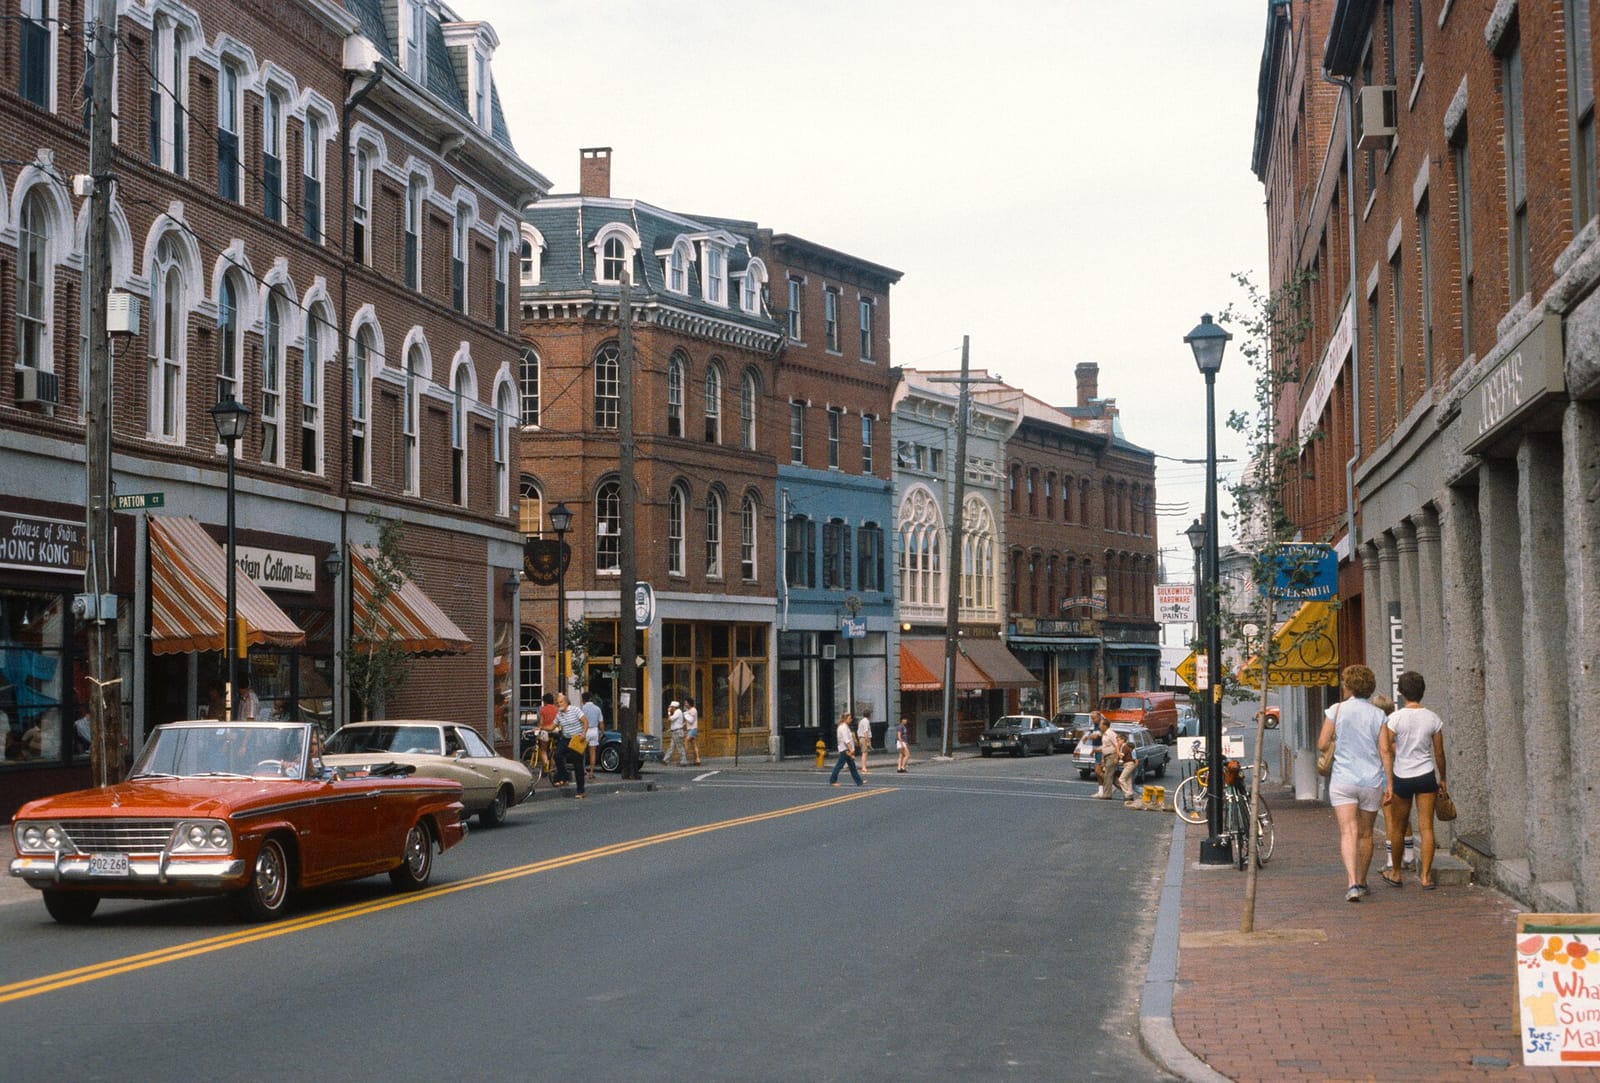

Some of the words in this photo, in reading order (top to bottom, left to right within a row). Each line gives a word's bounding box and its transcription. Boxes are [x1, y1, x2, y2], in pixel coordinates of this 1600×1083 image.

[119, 495, 145, 508] PATTON
[152, 496, 159, 504] CT
[12, 519, 40, 539] House
[44, 523, 54, 542] of
[56, 524, 77, 543] India
[0, 537, 35, 562] HONG
[39, 542, 69, 565] KONG
[264, 553, 294, 583] Cotton
[1160, 596, 1191, 604] HARDWARE
[1162, 612, 1189, 620] PAINTS
[91, 858, 108, 871] 902
[1552, 971, 1600, 1000] Wha
